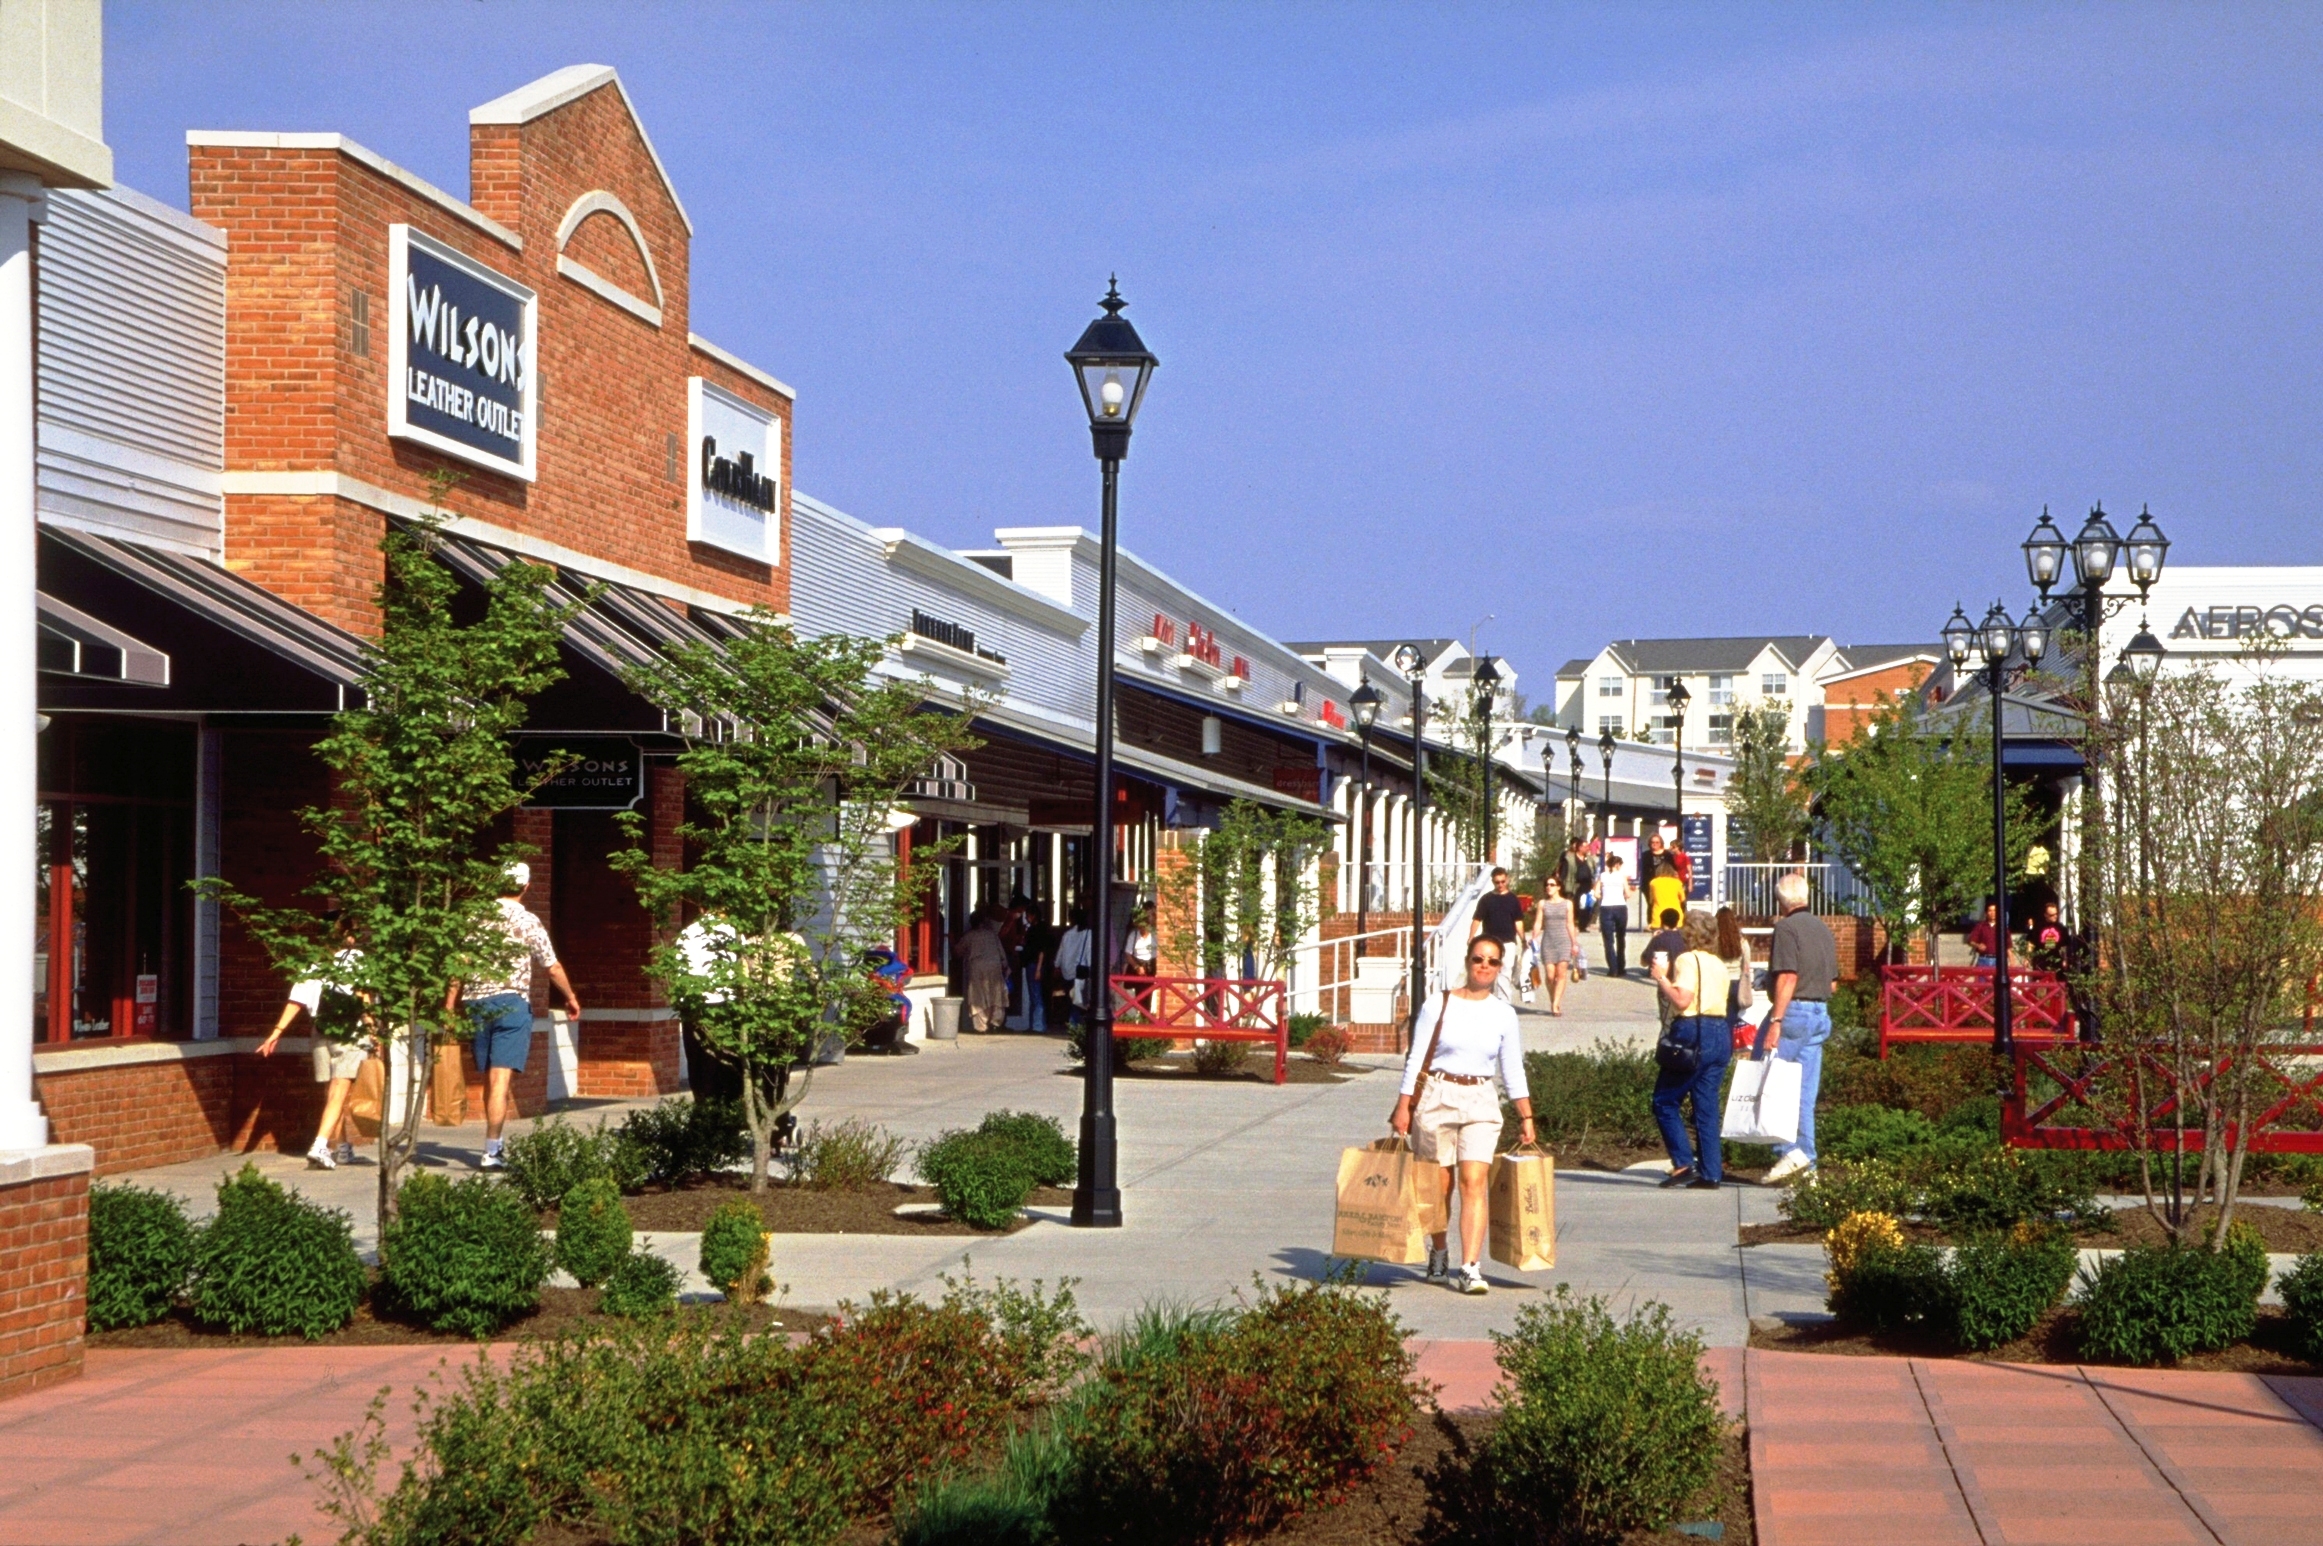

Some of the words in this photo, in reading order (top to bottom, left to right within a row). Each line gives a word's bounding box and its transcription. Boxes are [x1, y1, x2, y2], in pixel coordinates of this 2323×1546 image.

[407, 272, 526, 392] WILSONS
[408, 366, 473, 423] LEATHER
[477, 396, 525, 444] OUTLET
[2172, 604, 2323, 640] AEROS
[517, 777, 576, 787] LEHER
[581, 777, 633, 787] OUTLET
[521, 758, 629, 773] WSONS
